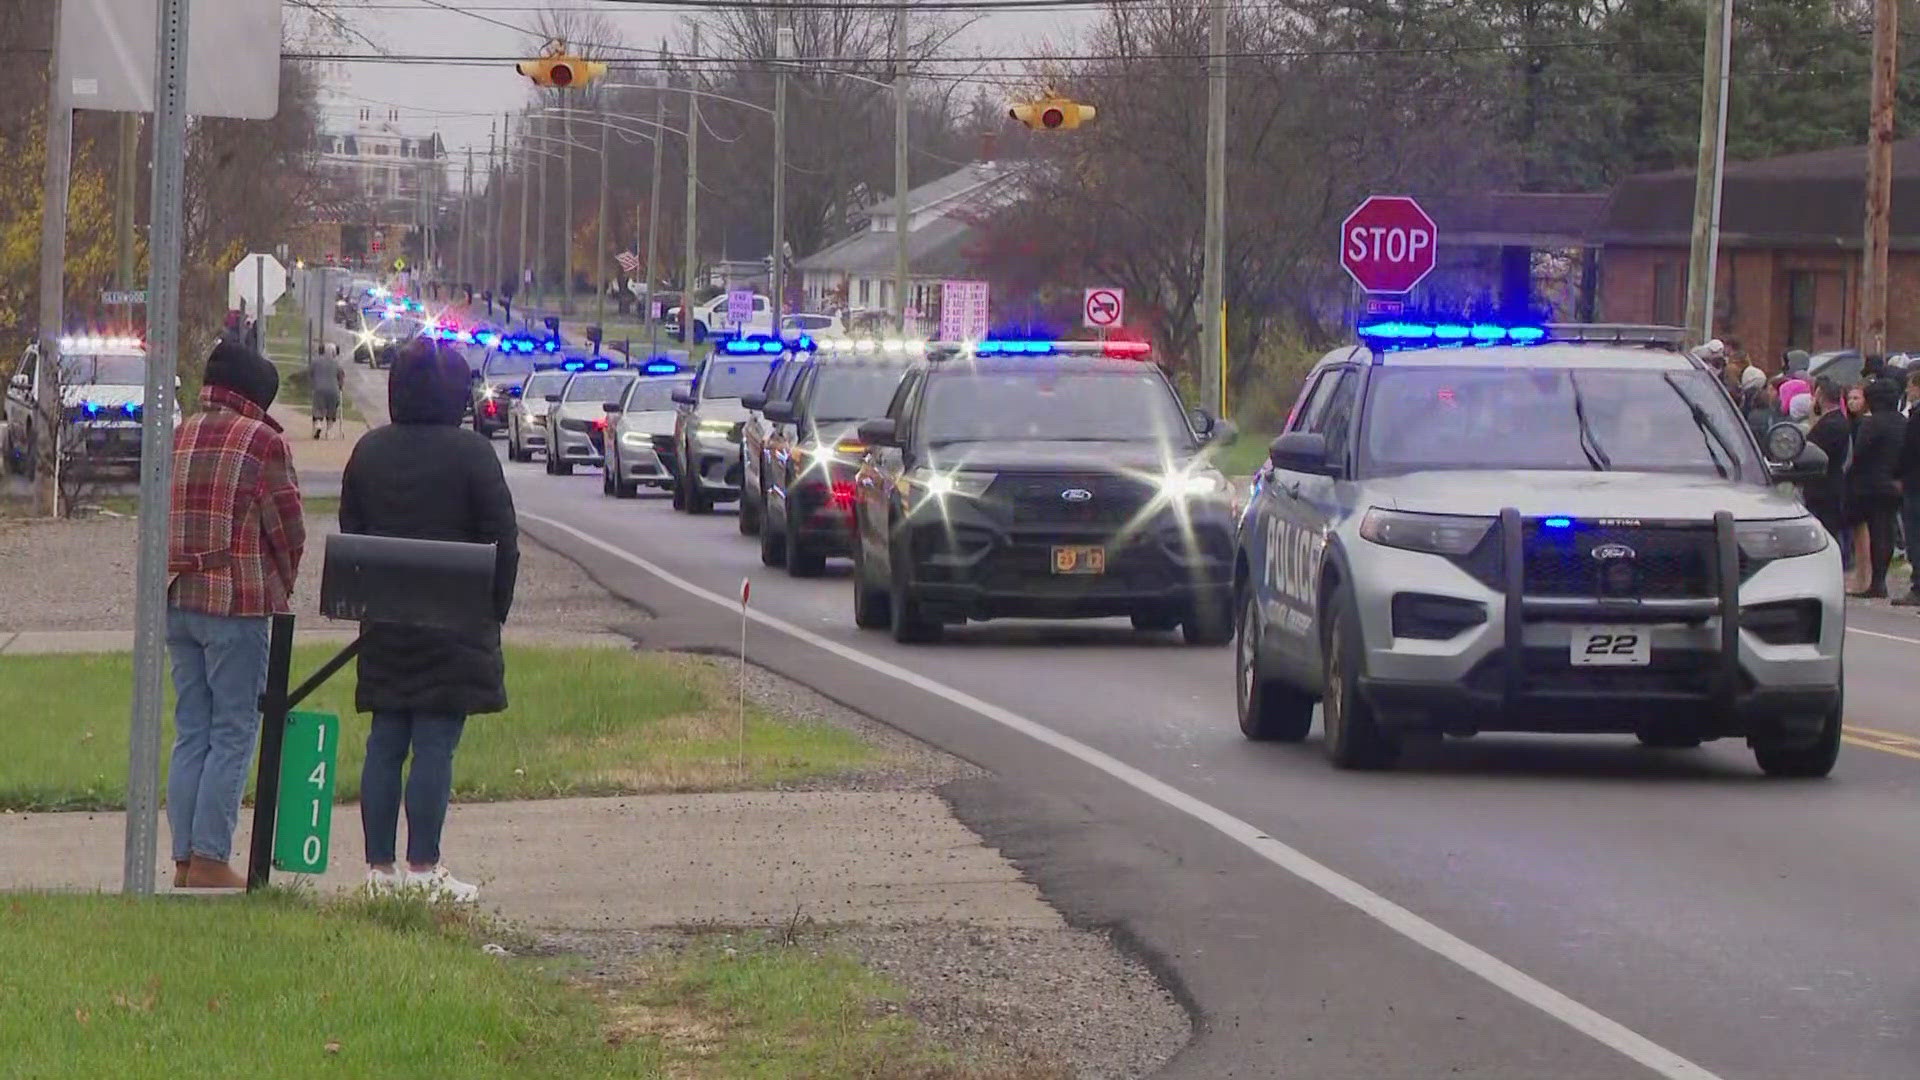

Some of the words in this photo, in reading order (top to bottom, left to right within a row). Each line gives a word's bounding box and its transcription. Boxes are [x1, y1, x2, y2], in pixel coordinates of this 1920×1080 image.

[1348, 227, 1429, 263] STOP
[1264, 515, 1324, 607] POLICE
[1585, 635, 1639, 655] 22
[303, 723, 327, 866] 1410
